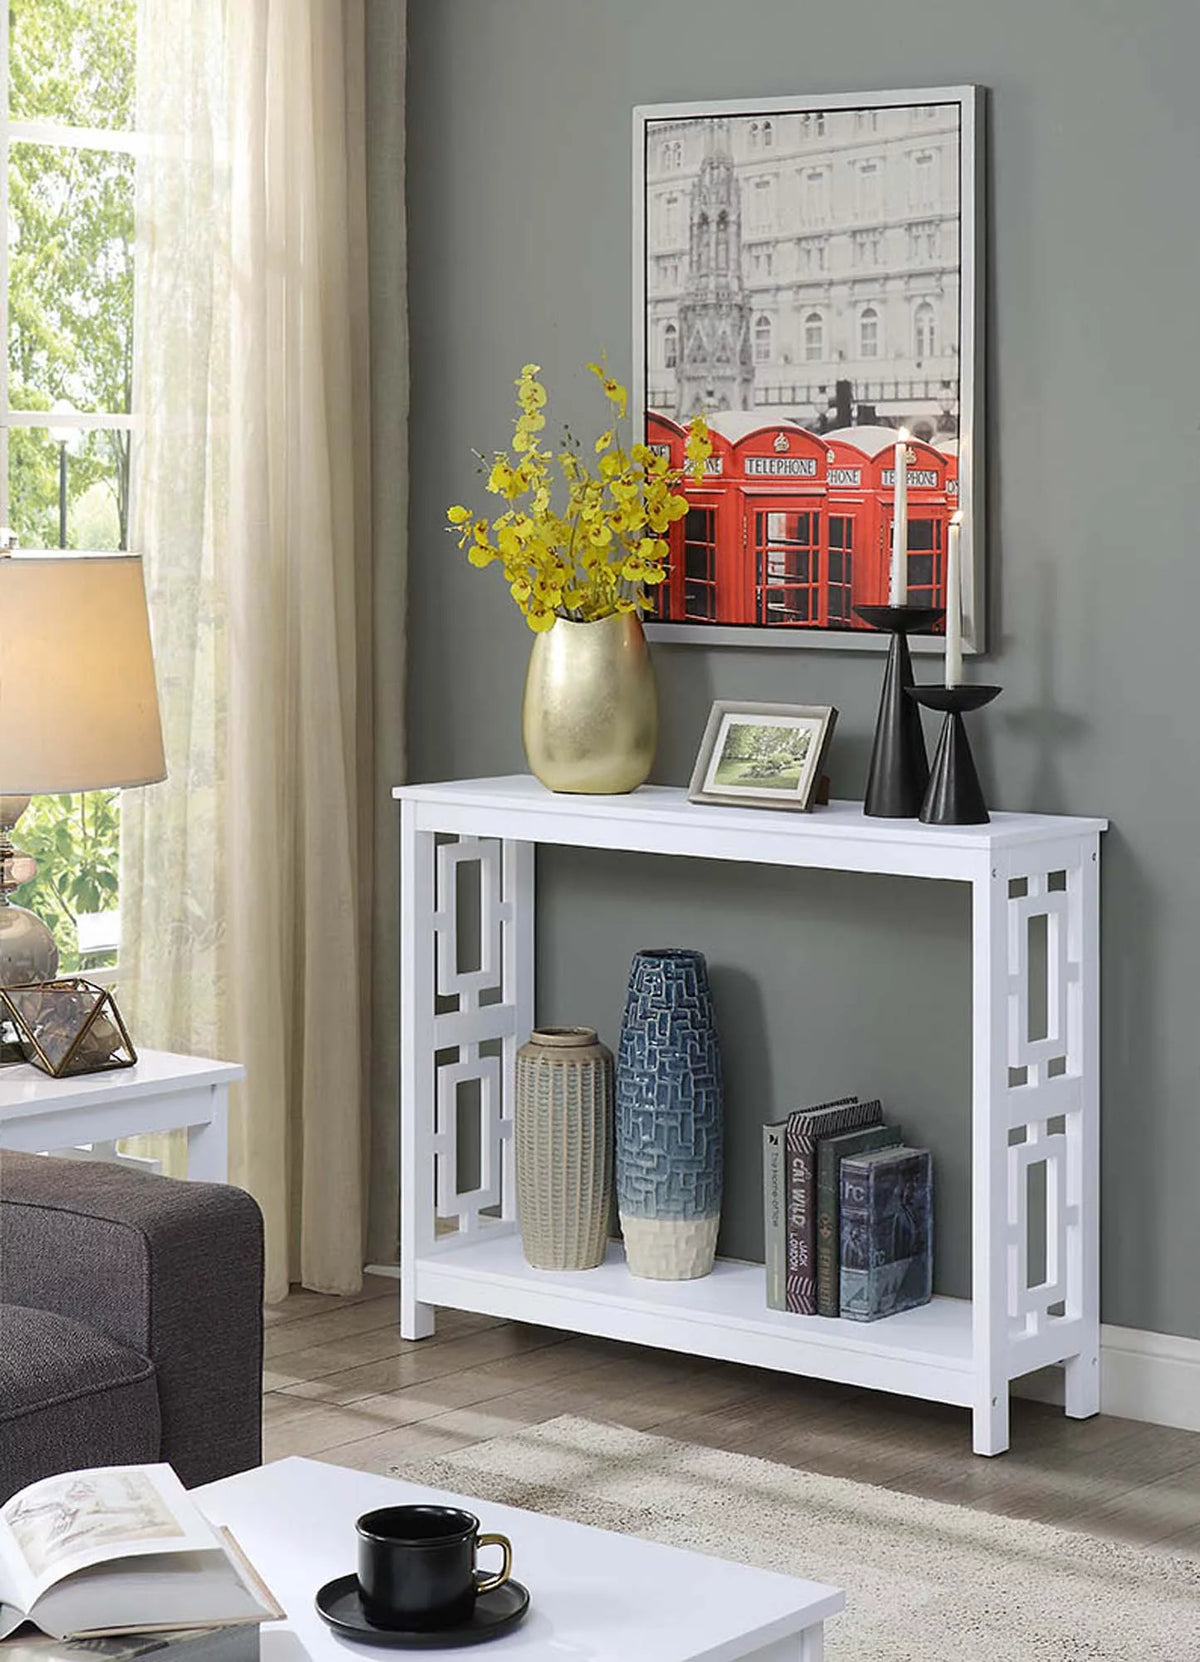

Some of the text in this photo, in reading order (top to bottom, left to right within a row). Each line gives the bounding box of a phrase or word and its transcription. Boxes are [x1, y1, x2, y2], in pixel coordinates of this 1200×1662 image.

[747, 459, 814, 475] TELEPHONE
[882, 469, 936, 486] TEPHONE
[791, 1188, 806, 1227] WILD
[789, 1232, 799, 1272] LONDON
[799, 1239, 808, 1267] JACK
